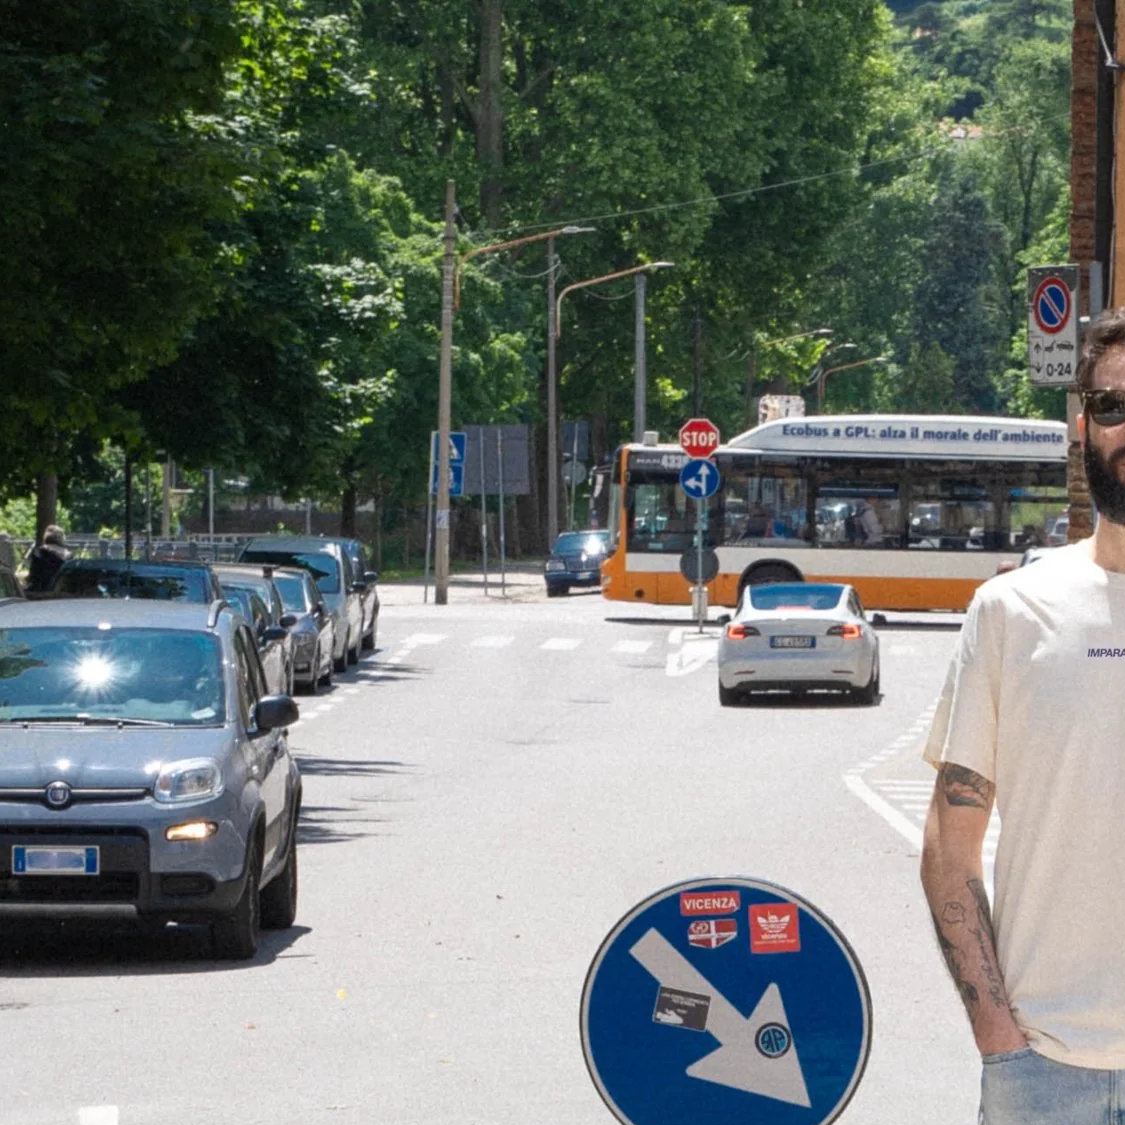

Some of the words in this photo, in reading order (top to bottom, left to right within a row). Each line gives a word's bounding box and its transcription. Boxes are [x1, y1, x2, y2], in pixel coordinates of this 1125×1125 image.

[1046, 363, 1071, 376] 0-24
[682, 432, 717, 447] STOP
[782, 425, 829, 437] Ecobus
[833, 428, 841, 437] a
[844, 426, 876, 438] GPL:
[879, 428, 906, 439] alza
[910, 426, 919, 439] il
[923, 427, 970, 441] morale
[683, 897, 737, 910] VICENZA
